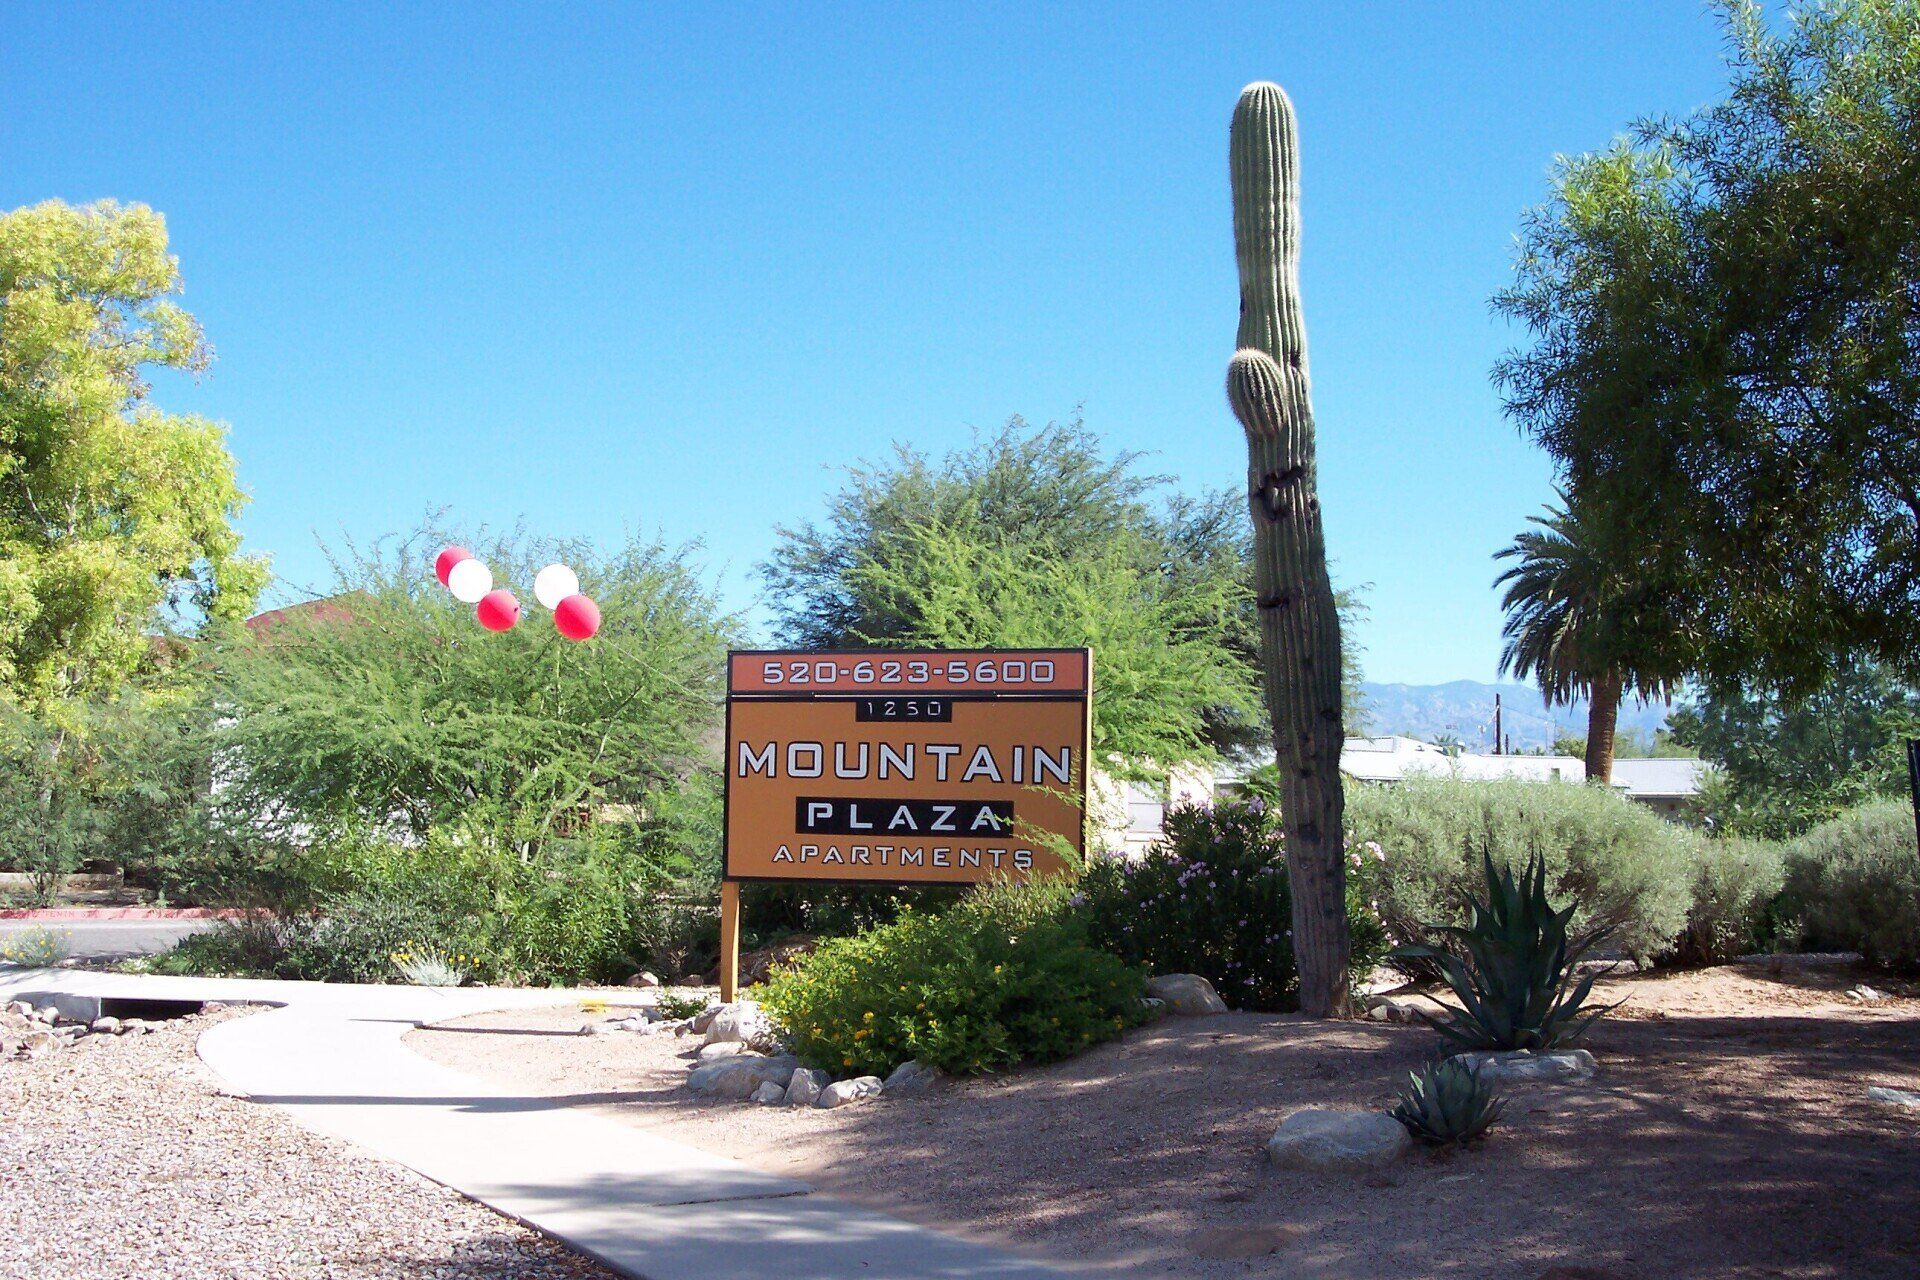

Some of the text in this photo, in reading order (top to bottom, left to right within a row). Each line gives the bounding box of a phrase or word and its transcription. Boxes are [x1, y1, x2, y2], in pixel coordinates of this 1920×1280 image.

[763, 661, 1055, 683] 520-623-5600
[867, 701, 941, 716] 1250
[738, 741, 1071, 784] MOUNTAIN
[807, 802, 1001, 832] PLAZA
[772, 845, 1033, 869] APARTMENTS
